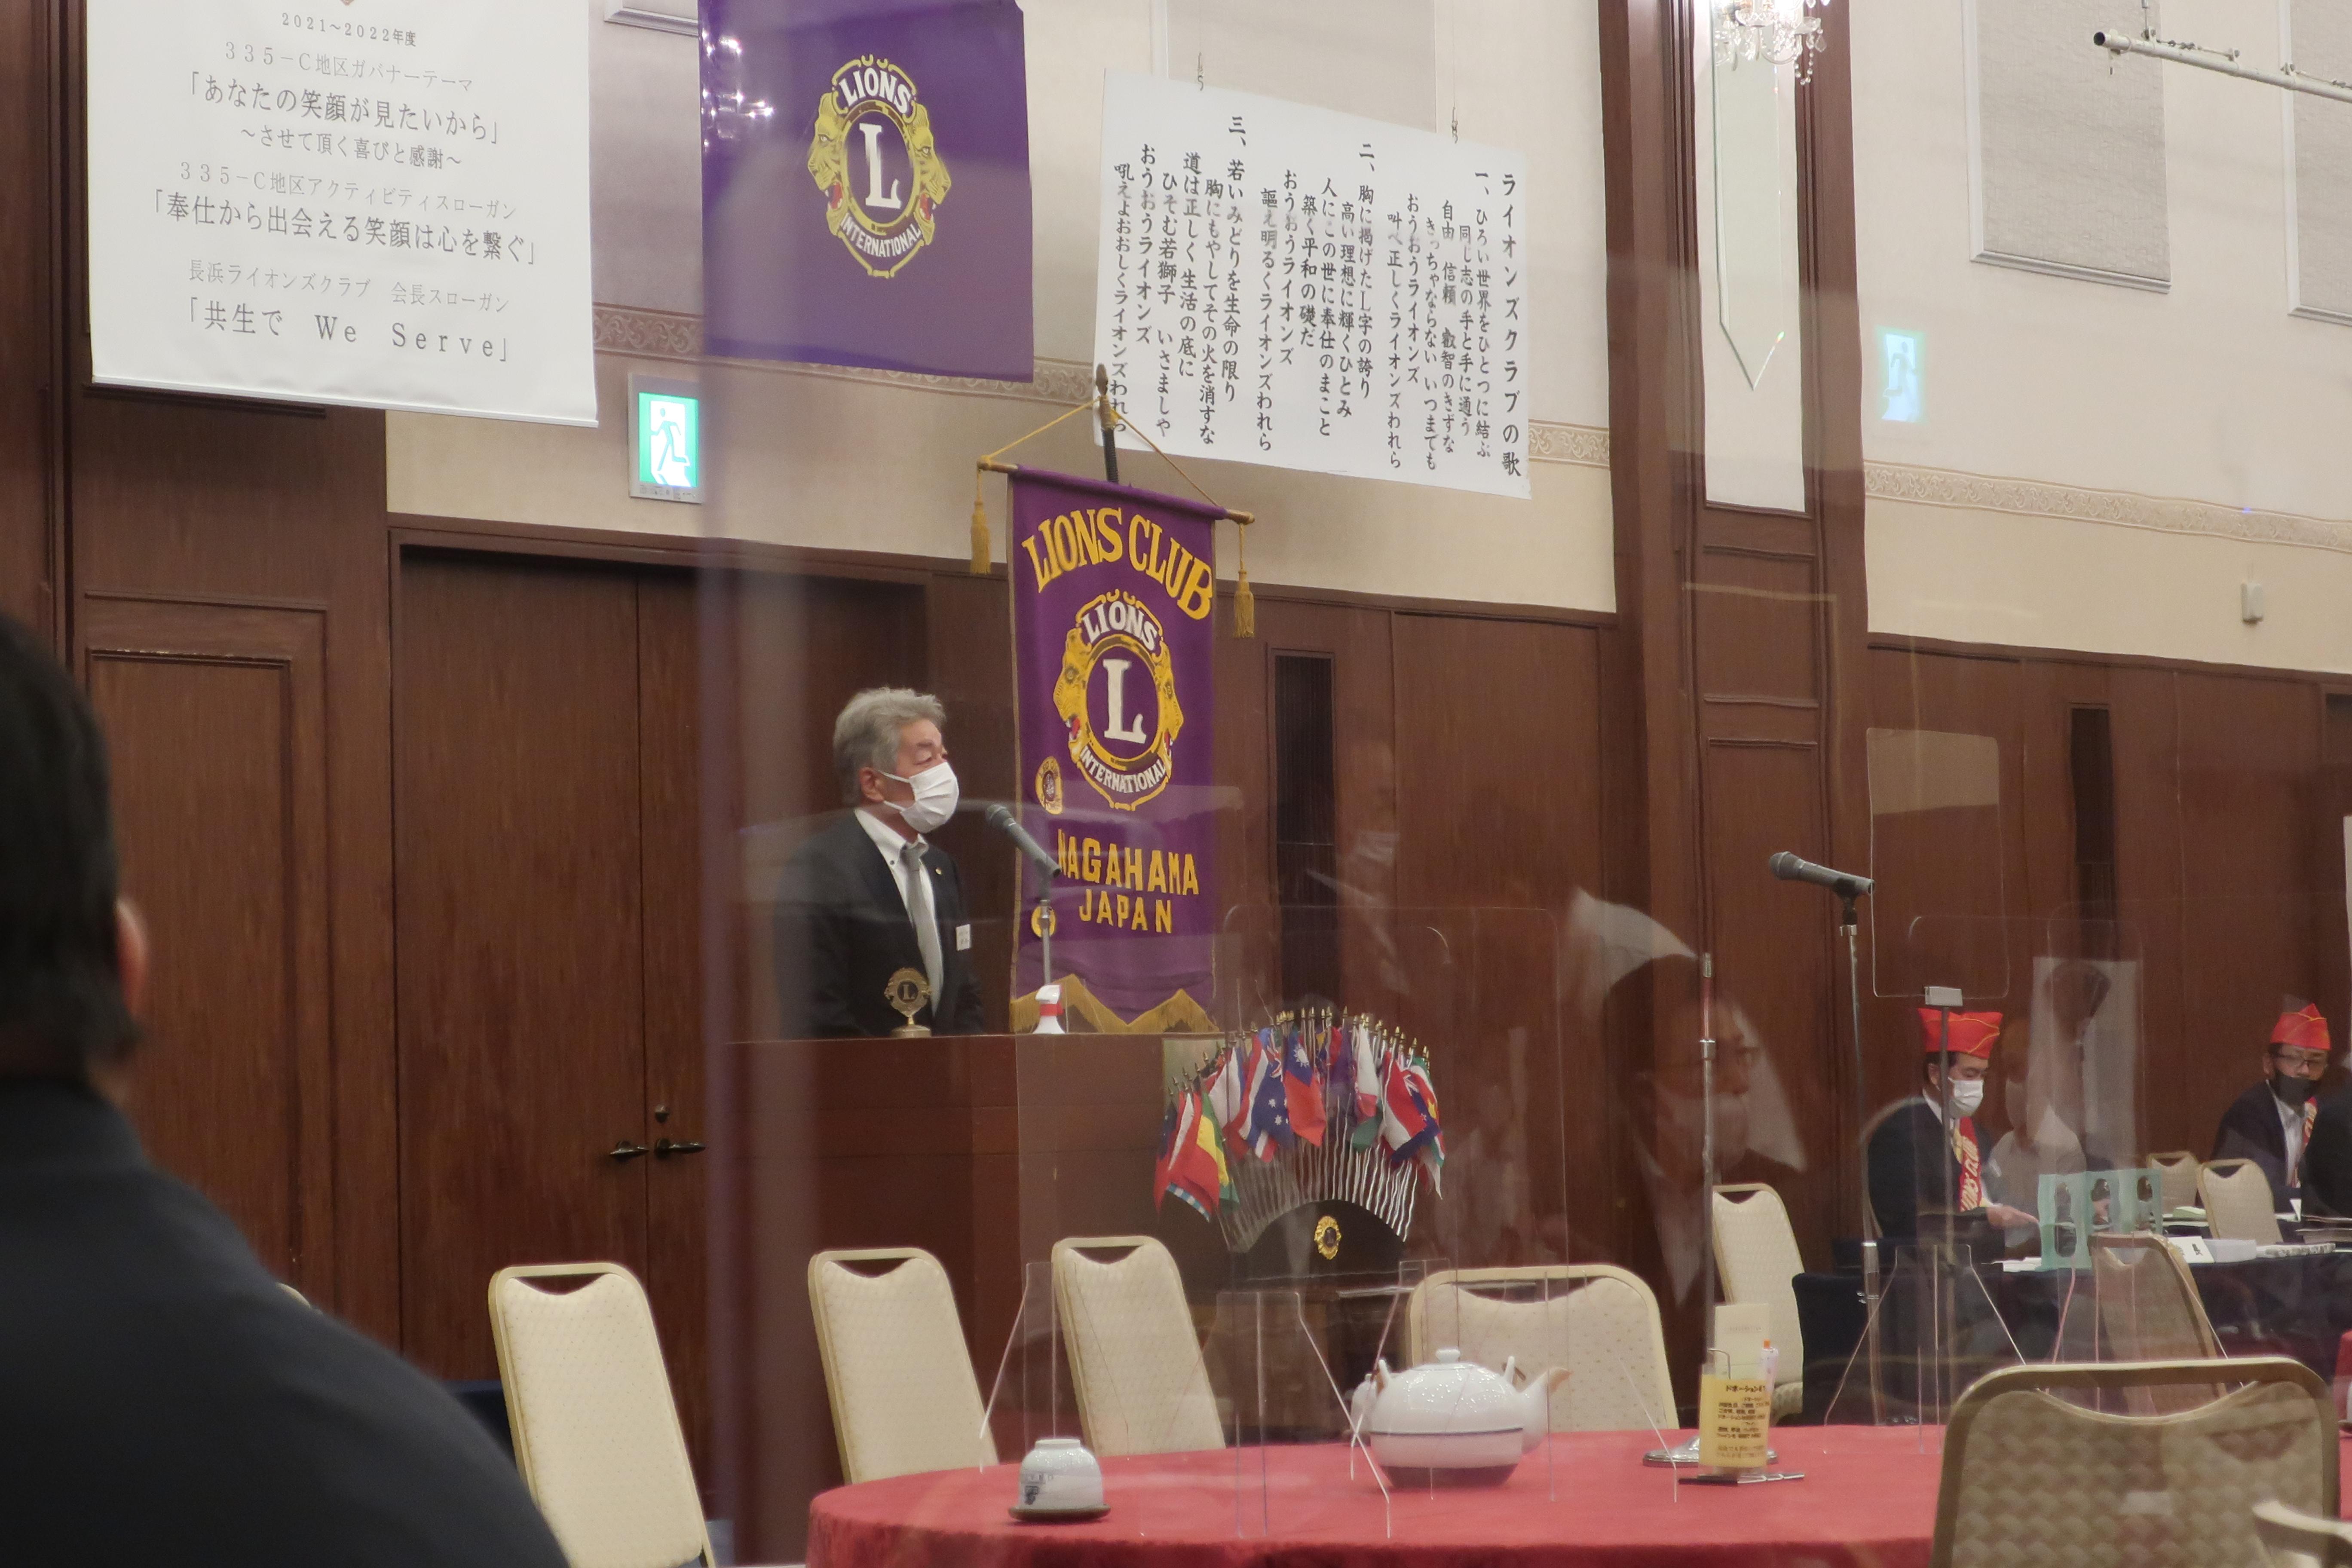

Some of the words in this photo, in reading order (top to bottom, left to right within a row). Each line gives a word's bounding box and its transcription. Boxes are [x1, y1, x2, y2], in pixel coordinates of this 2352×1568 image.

[192, 71, 496, 144] 「あなたの笑顔が見たいから」
[839, 67, 911, 114] LIONS
[859, 122, 901, 209] L
[156, 189, 534, 265] 「奉仕から出会える笑顔は心を繋ぐ」
[840, 213, 922, 258] INTERNATIONAL
[1136, 144, 1155, 344] おうおうライオンズ
[1280, 169, 1298, 365] おうおうライオンズ
[189, 259, 371, 298] 長浜ライオンズクラブ
[391, 282, 509, 312] 会長スローガン
[1200, 179, 1223, 444] 胸にもやしてその火を消すな
[1299, 194, 1318, 347] 築く平和の礎だ
[1319, 177, 1337, 436] 人にこの世に奉仕のまこと
[1337, 202, 1356, 417] 高い理想に輝くひとみ
[1407, 193, 1420, 383] おうおうライオンズ
[314, 315, 357, 343] We
[1458, 225, 1473, 436] 同じ志の手と手に通う
[1501, 174, 1522, 476] ライオンズクラブの歌
[1021, 508, 1123, 593] LIONS
[1129, 514, 1213, 620] CLUB
[1081, 601, 1158, 651] LIONS
[1103, 658, 1147, 744] L
[1080, 745, 1167, 793] INTERNATIONAL
[1057, 828, 1199, 895] NAGAHAMA
[1078, 888, 1172, 934] JAPAN
